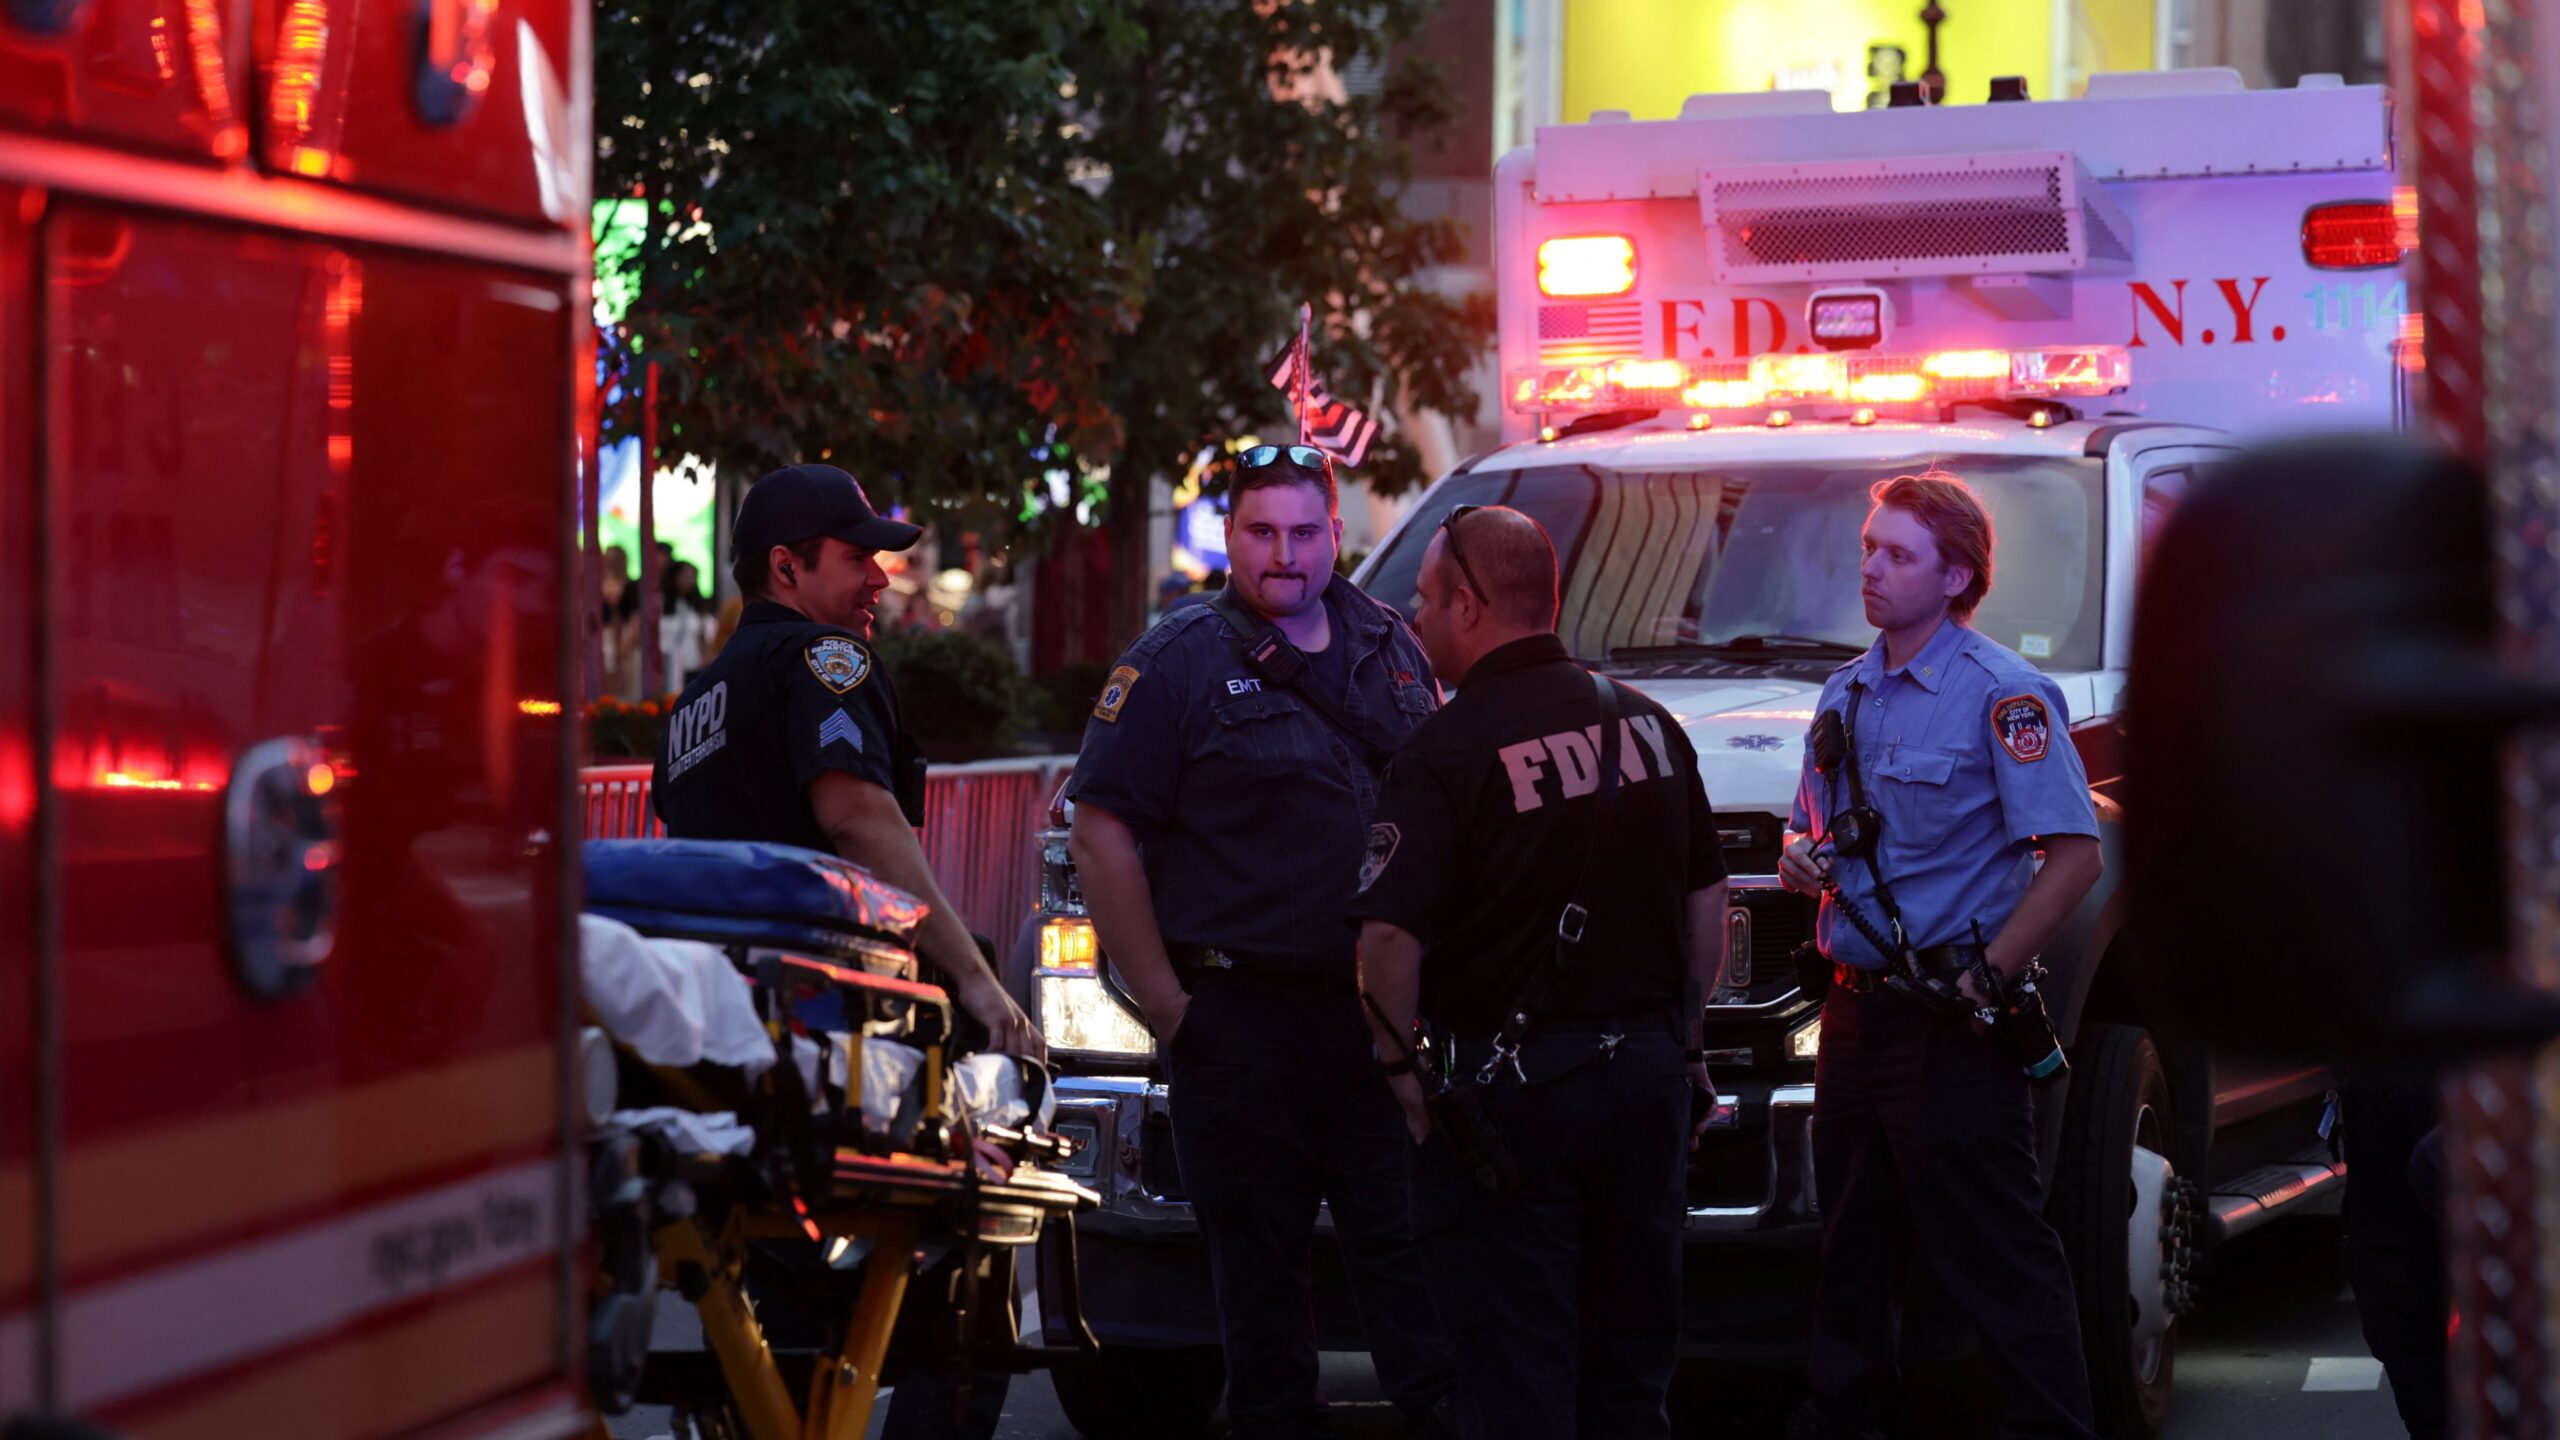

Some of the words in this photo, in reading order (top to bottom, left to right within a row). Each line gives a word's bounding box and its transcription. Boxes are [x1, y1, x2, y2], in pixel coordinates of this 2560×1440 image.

[1660, 298, 1810, 359] F.D.
[2127, 277, 2286, 347] N.Y.
[2304, 280, 2407, 329] 1114
[823, 640, 854, 650] POLICE
[1226, 679, 1262, 695] EMT
[668, 681, 727, 765] NYPD
[2009, 708, 2021, 716] CITY
[1498, 715, 1674, 813] FDNY
